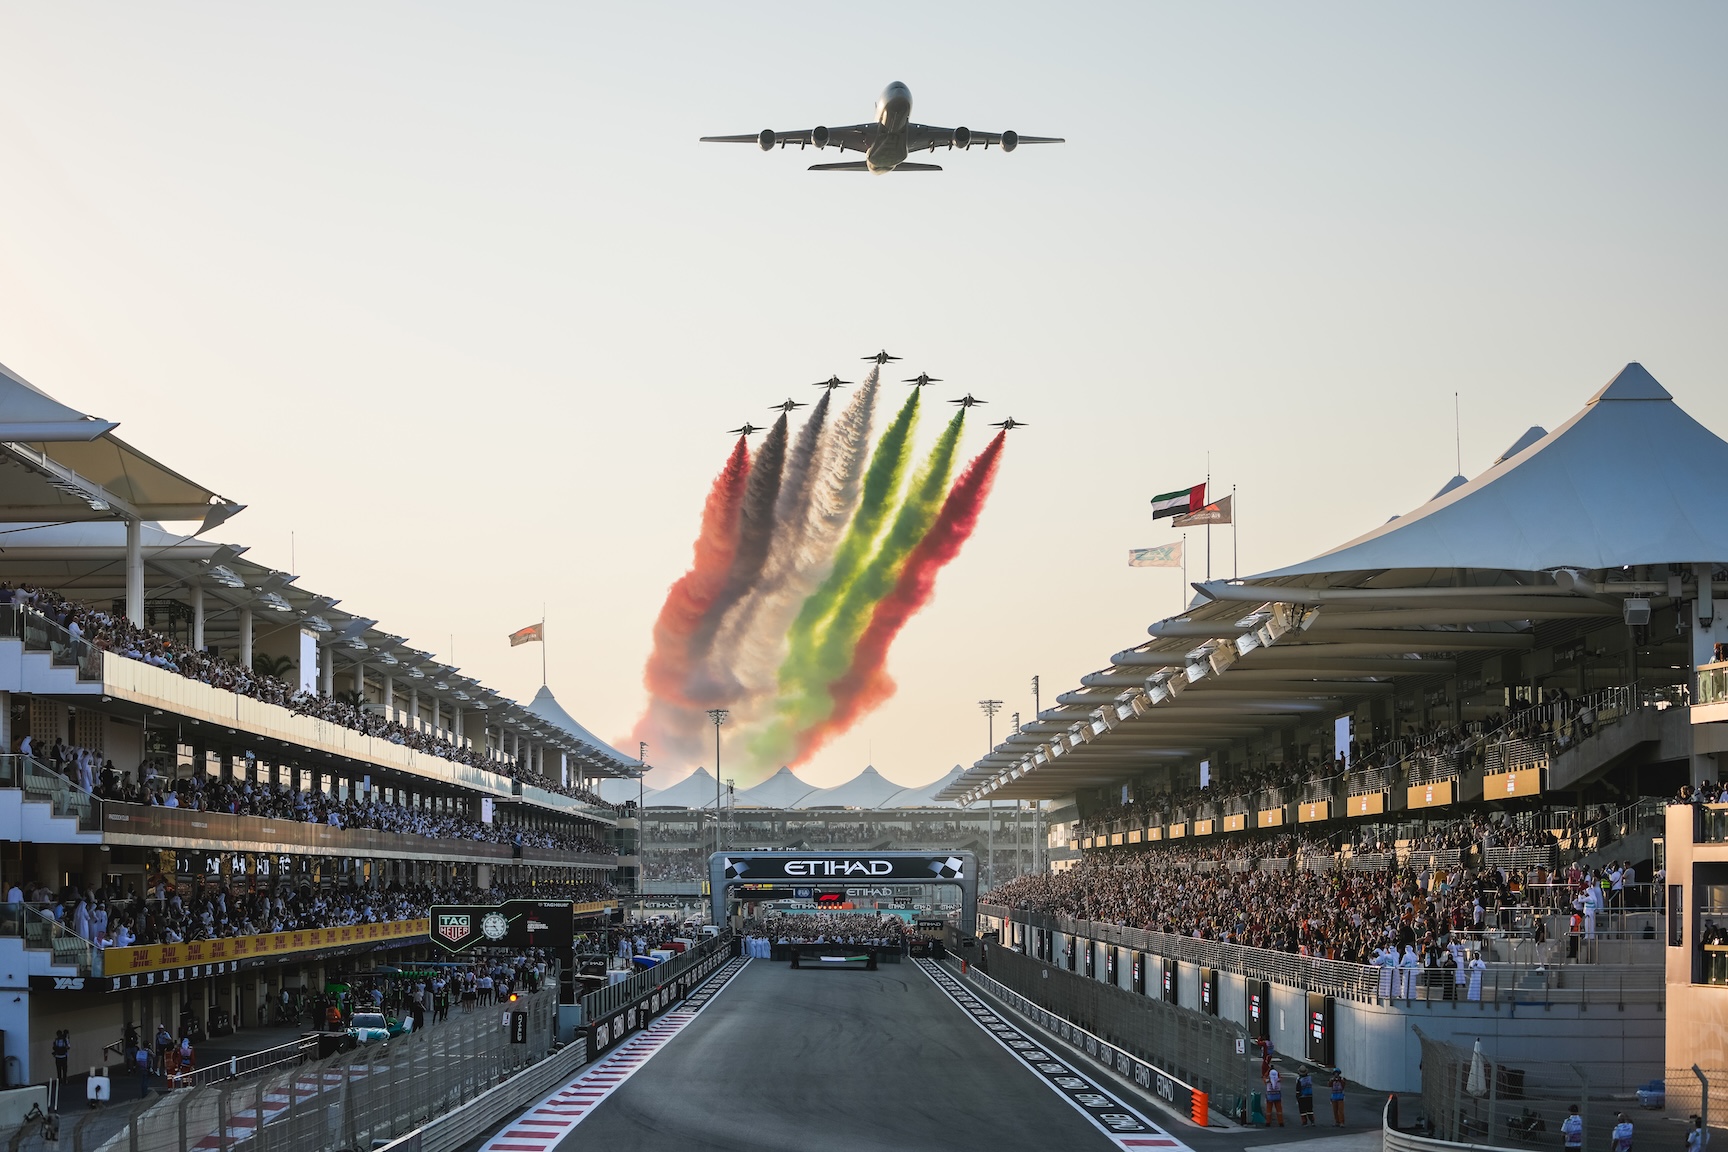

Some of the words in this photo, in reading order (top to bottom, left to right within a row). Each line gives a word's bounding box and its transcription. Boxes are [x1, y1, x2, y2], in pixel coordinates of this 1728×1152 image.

[784, 860, 893, 875] ETIHAD
[846, 888, 892, 896] ETIHAD
[441, 917, 467, 925] TAG
[440, 927, 468, 939] HEUER
[53, 977, 85, 990] YAS
